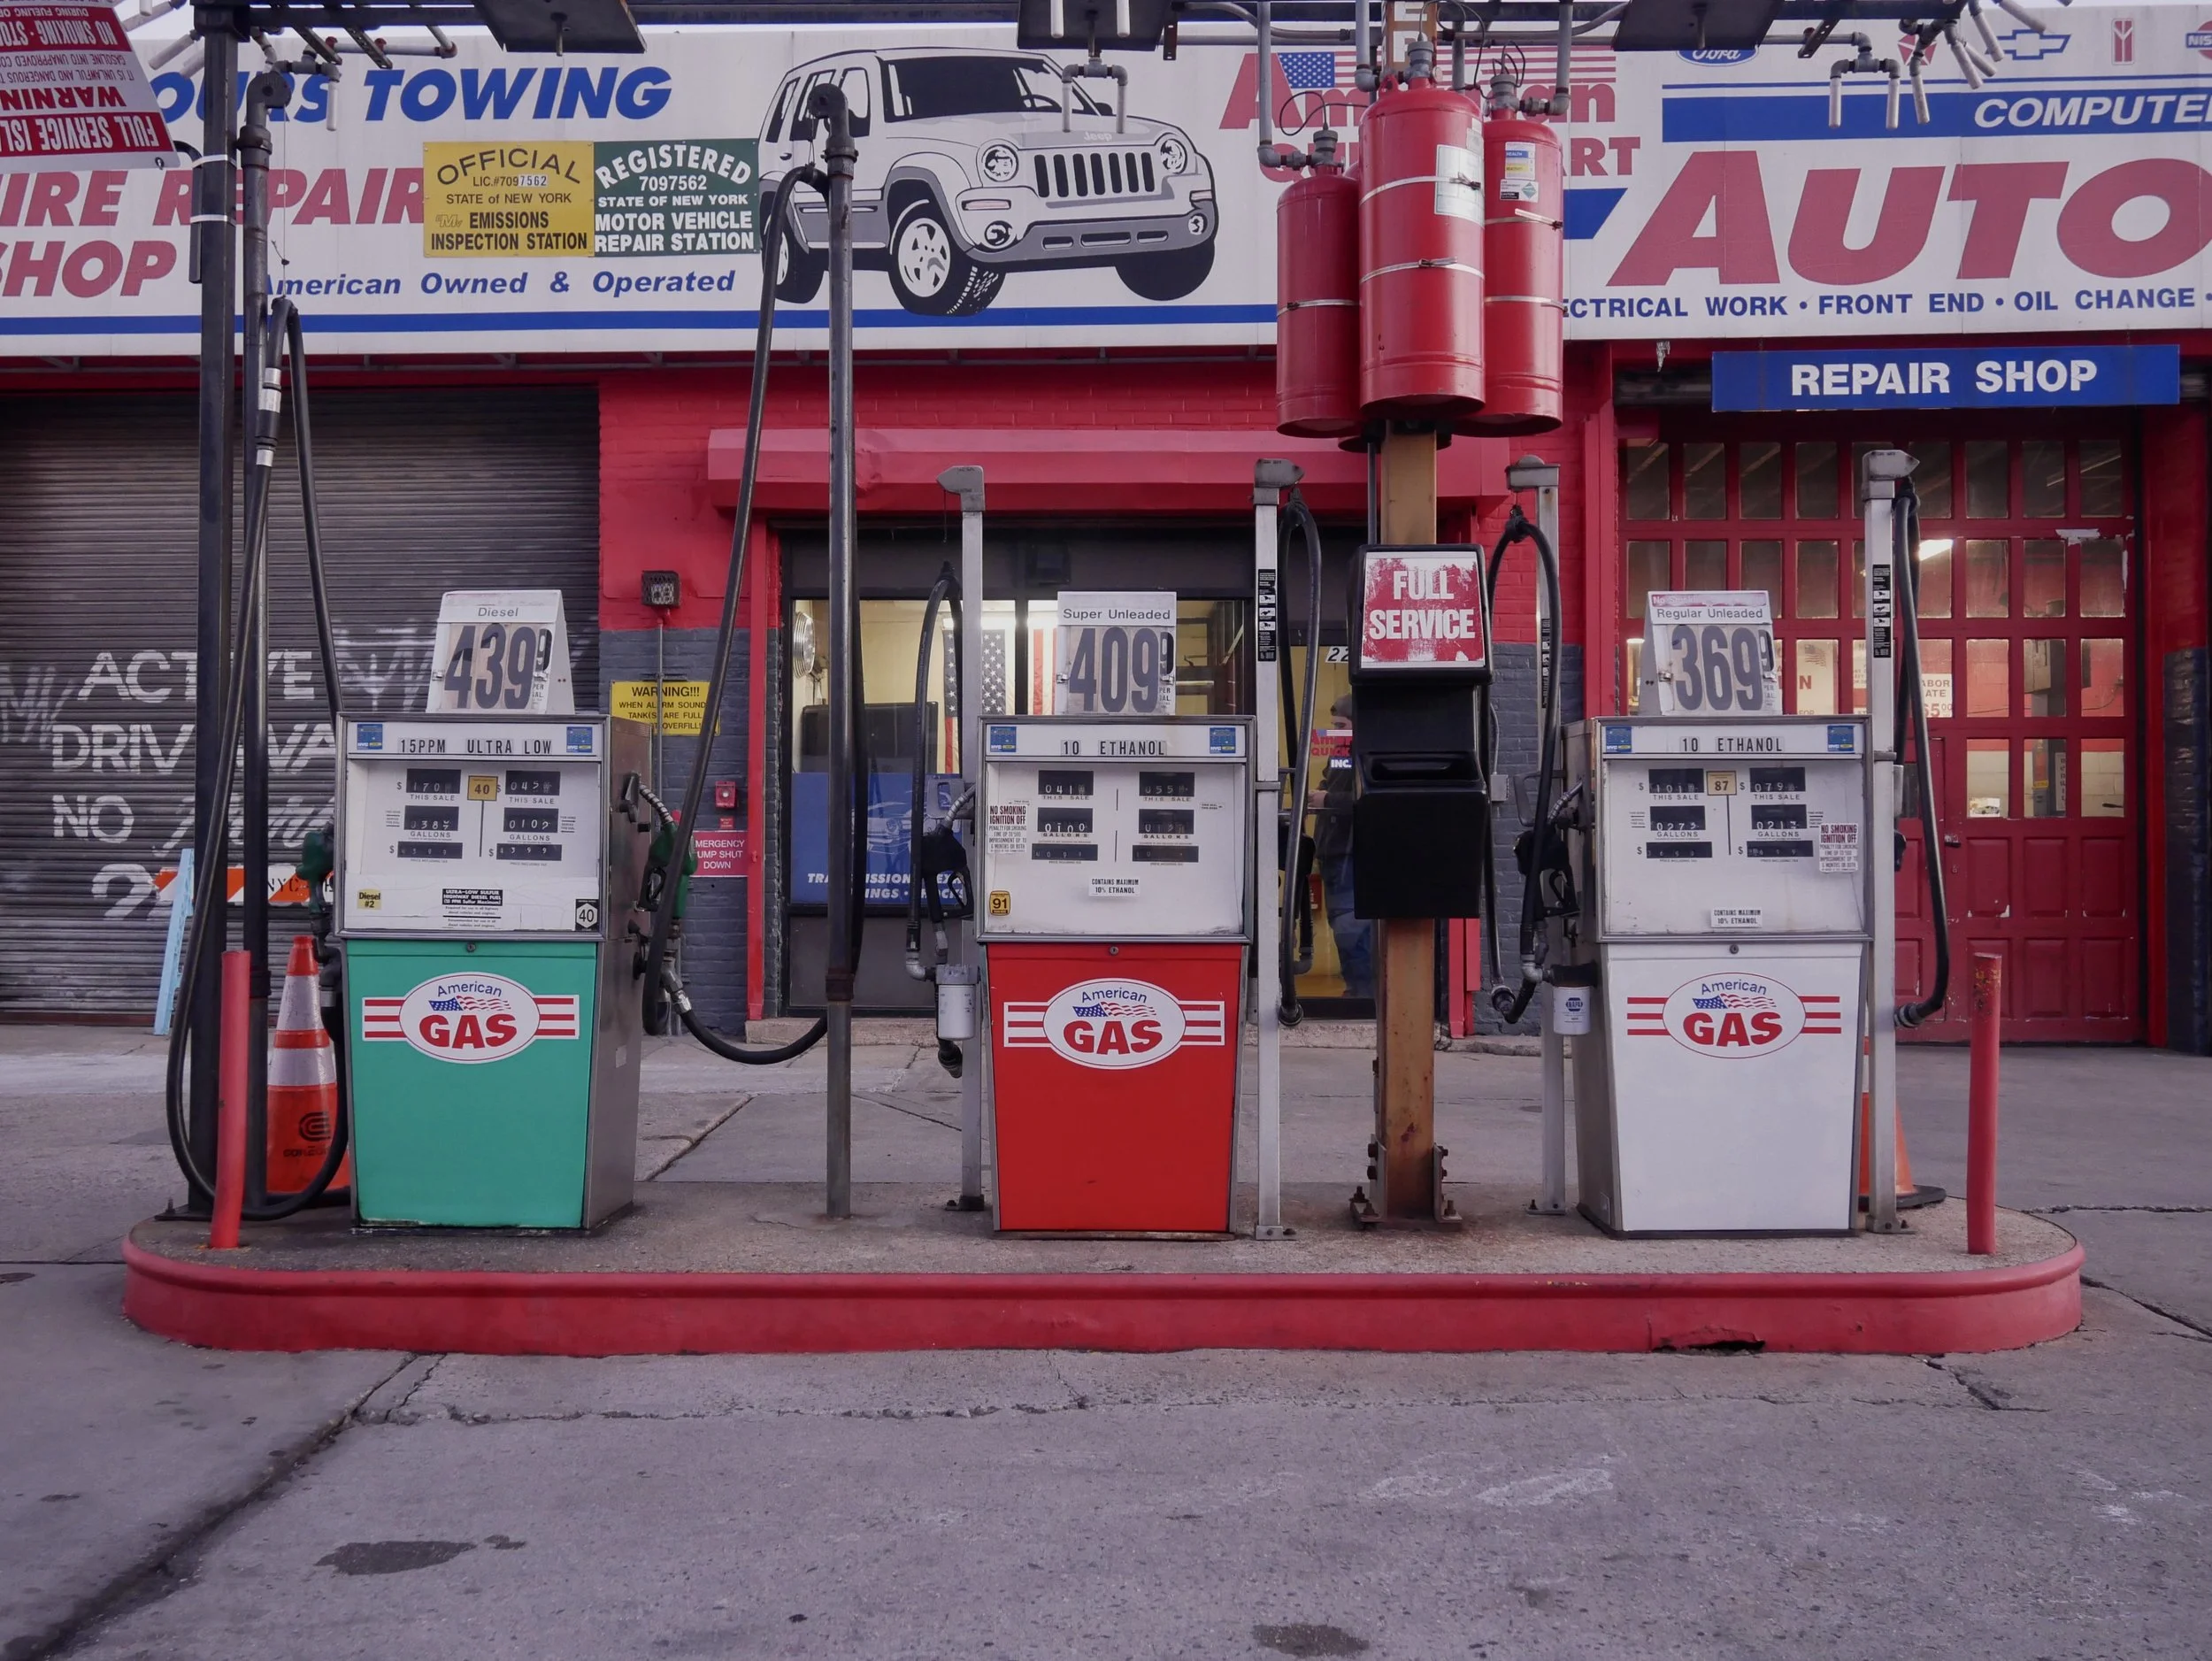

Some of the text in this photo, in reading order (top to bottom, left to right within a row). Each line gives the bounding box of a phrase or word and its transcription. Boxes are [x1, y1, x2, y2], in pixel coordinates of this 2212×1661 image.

[15, 8, 88, 17] DURING FUELING
[35, 20, 96, 45] SMOKING
[95, 20, 118, 45] NO
[15, 54, 127, 67] GASOLINE INTO UNAPPROVED
[7, 70, 57, 84] DANGEROUS
[60, 71, 73, 82] AND
[77, 70, 117, 82] UNLAWFUL
[119, 70, 126, 81] IS
[364, 66, 672, 122] TOWING
[0, 116, 160, 153] FULL SERVICE ISL
[1084, 131, 1112, 142] Jeep
[437, 148, 581, 185] OFFICIAL
[595, 144, 751, 189] REGISTERED
[639, 174, 707, 191] 7097562
[0, 167, 424, 227] IRE RPAIR
[446, 193, 572, 204] STATE of NEW YORK
[598, 194, 749, 207] STATE OF NEW YORK
[469, 211, 549, 229] EMISSIONS
[595, 211, 752, 232] MOTOR VEHICLE
[1605, 150, 2212, 287] AUTO
[431, 232, 588, 250] INSPECTION STATION
[594, 232, 754, 252] REPAIR STATION
[0, 240, 177, 297] HOP
[420, 272, 528, 295] Owned
[549, 271, 570, 294] &
[593, 270, 736, 298] Operated
[1705, 296, 1788, 317] WORK
[1819, 293, 1912, 315] FRONT
[1929, 292, 1985, 313] END
[2014, 290, 2058, 311] OIL
[2075, 288, 2195, 310] CHANGE
[1791, 359, 2097, 396] REPAIR SHOP
[1393, 570, 1455, 600] FULL
[478, 606, 518, 618] Diesel
[1063, 609, 1171, 620] Super Unleaded
[1657, 608, 1763, 620] Regular Unleaded
[1369, 609, 1476, 640] SERVICE
[443, 623, 537, 710] 439
[1069, 627, 1159, 713] 409
[1671, 624, 1763, 711] 369
[632, 686, 700, 697] WARNING!!!
[400, 739, 552, 755] 15PPM ULTRA LOW
[1064, 741, 1164, 756] 10 ETHANOL
[1683, 737, 1783, 753] 10 ETHANOL
[1330, 758, 1352, 768] INC.
[475, 784, 489, 795] 40
[1715, 781, 1729, 791] 87
[990, 805, 1026, 815] NO SMOKING
[53, 794, 134, 844] NO
[989, 815, 1025, 825] IGNITION OFF
[1821, 824, 1857, 834] NO SMOKING
[695, 840, 745, 849] MERGENCY
[1821, 834, 1856, 843] IGNITION OFF
[703, 861, 731, 870] DOWN
[993, 897, 1007, 909] 91
[579, 909, 594, 922] 40
[437, 980, 502, 997] American
[1700, 979, 1767, 996] American
[1081, 988, 1148, 1004] American
[419, 1013, 518, 1050] GAS
[1063, 1019, 1163, 1055] GAS
[1683, 1011, 1783, 1047] GAS
